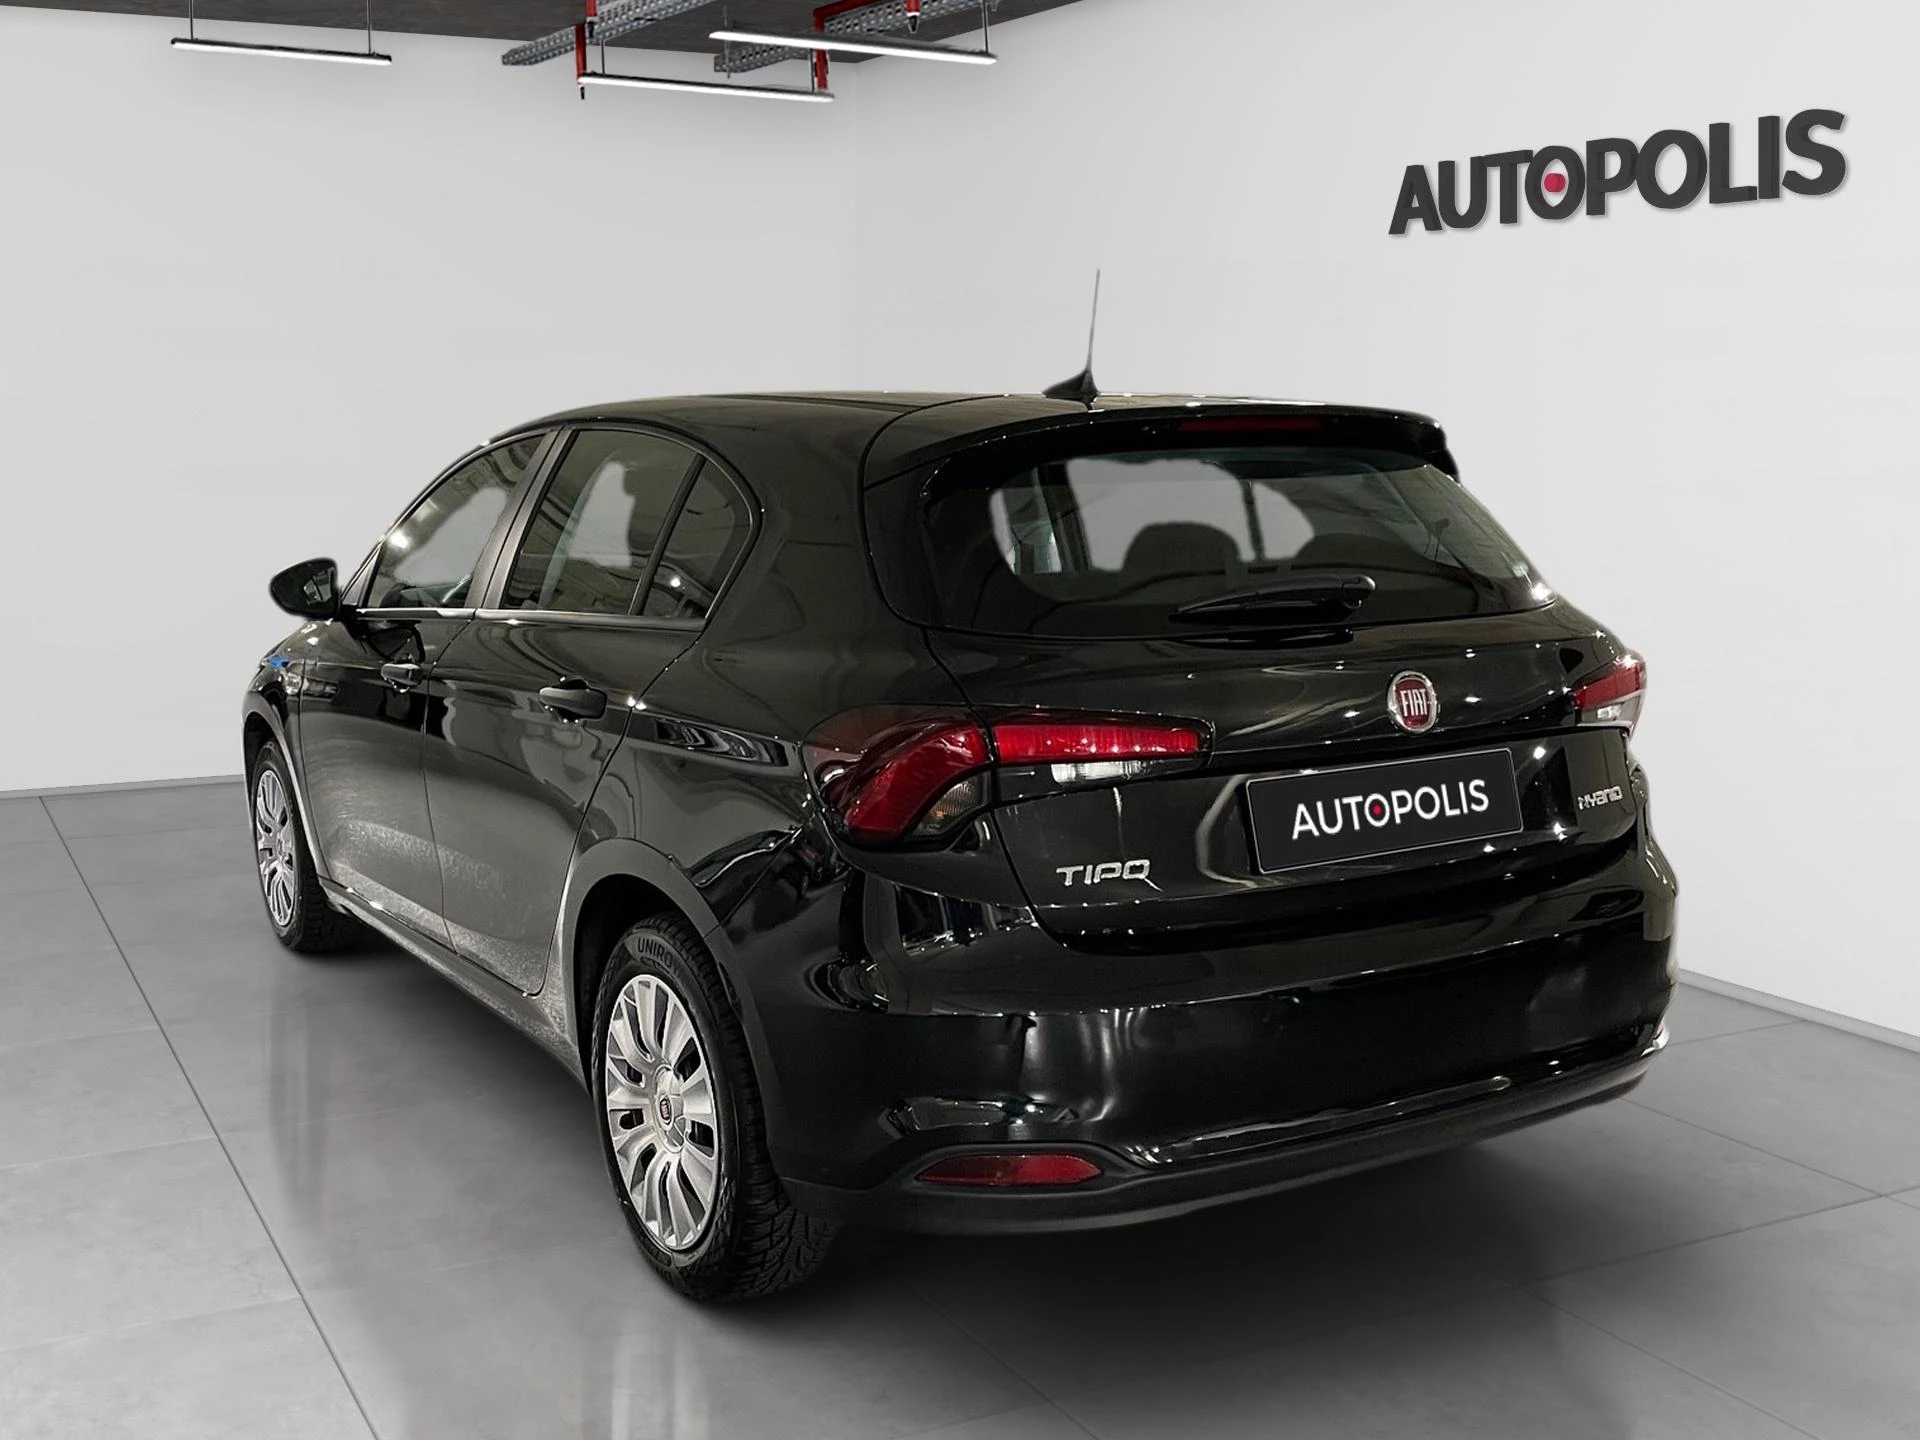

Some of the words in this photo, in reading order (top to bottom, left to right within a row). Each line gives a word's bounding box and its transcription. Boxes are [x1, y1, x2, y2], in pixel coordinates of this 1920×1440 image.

[1388, 109, 1846, 235] AUTOPOLIS
[1399, 688, 1428, 717] FIAT
[1292, 779, 1490, 840] AUTOPOLIS
